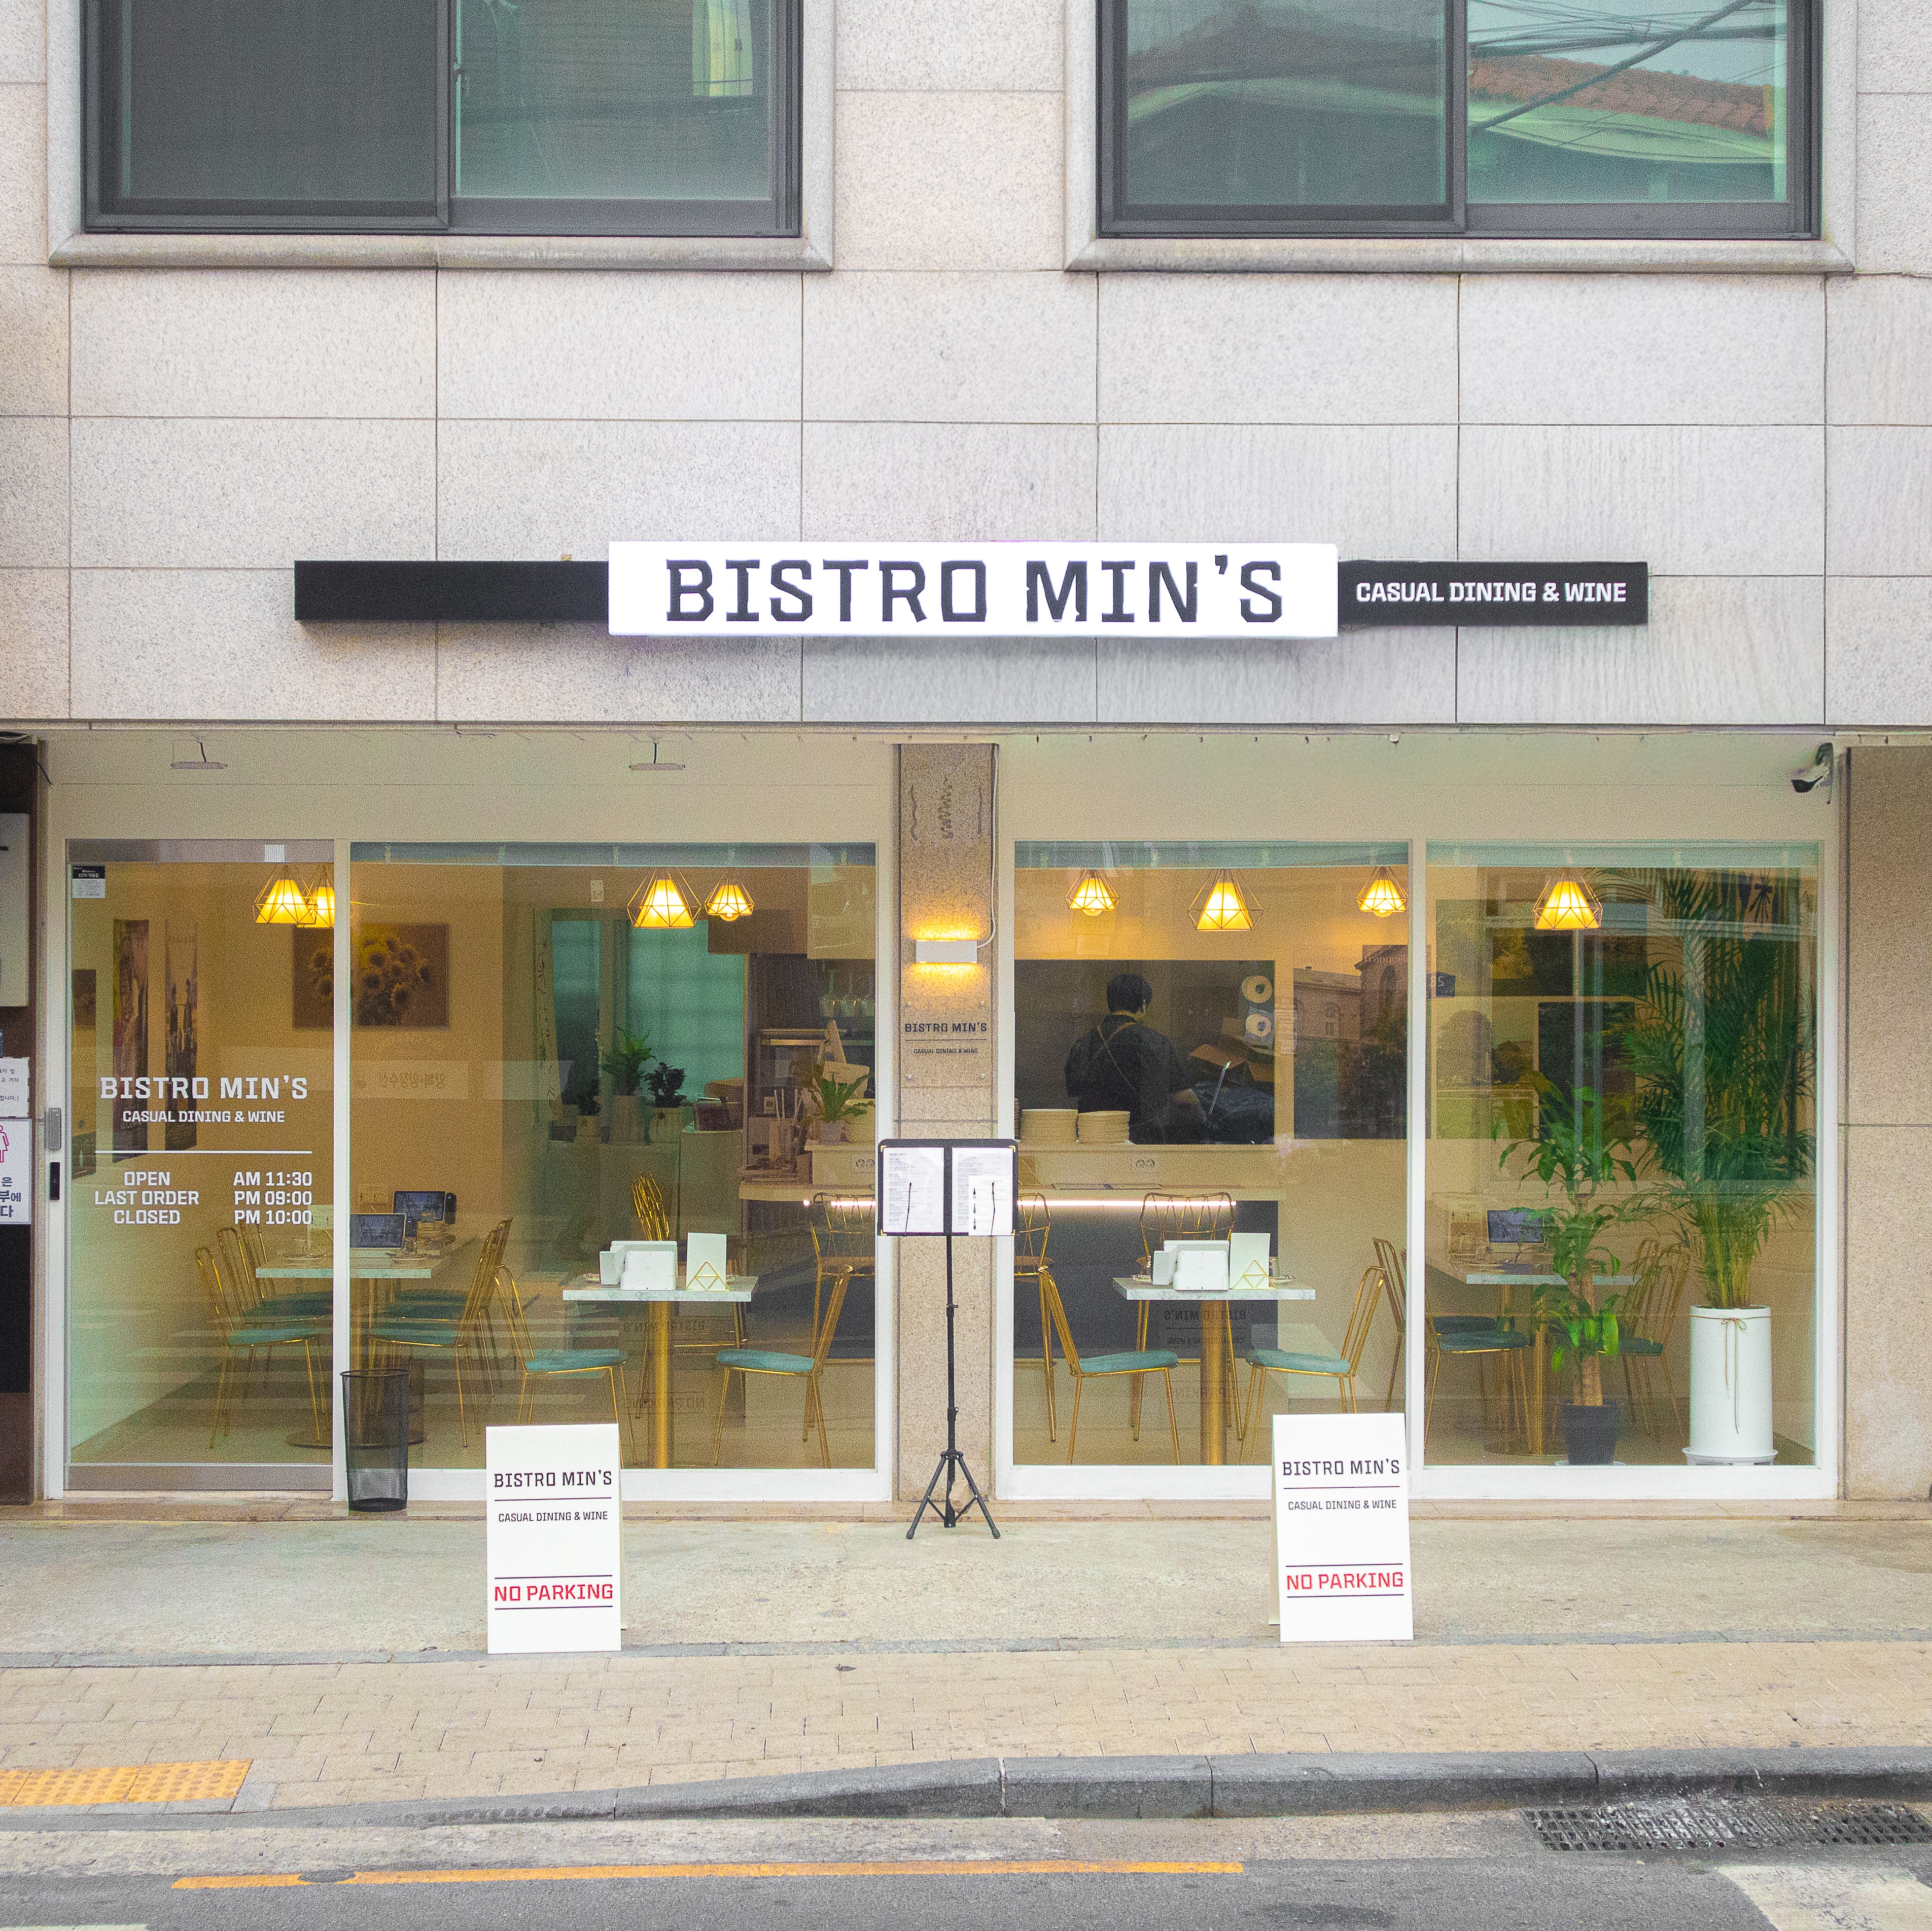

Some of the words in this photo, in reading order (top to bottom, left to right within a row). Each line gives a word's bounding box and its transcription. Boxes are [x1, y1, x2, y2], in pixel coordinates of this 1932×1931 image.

[667, 560, 987, 622] BISTRO
[1027, 555, 1282, 622] MIN'S
[1357, 583, 1444, 602] CASUAL
[1450, 583, 1536, 601] DINING
[1542, 583, 1559, 601] &
[1565, 583, 1626, 602] WINE
[905, 1023, 947, 1032] BISTRO
[952, 1022, 987, 1032] MIN'S
[100, 1077, 208, 1099] BISTRO
[221, 1075, 307, 1099] MIN'S
[123, 1111, 175, 1122] CASUAL
[179, 1111, 231, 1122] DINING
[235, 1111, 244, 1122] &
[248, 1111, 284, 1122] WINE
[124, 1172, 170, 1186] OPEN
[233, 1172, 260, 1186] AM
[266, 1172, 312, 1186] 11:30
[95, 1191, 137, 1204] LAST
[142, 1191, 198, 1204] ORDER
[235, 1191, 260, 1204] PM
[265, 1191, 312, 1204] 09:00
[114, 1210, 180, 1224] CLOSED
[234, 1210, 260, 1224] PM
[266, 1210, 312, 1224] 10:00
[1283, 1461, 1343, 1475] BISTRO
[1351, 1458, 1399, 1474] MIN'S
[495, 1473, 555, 1487] BISTRO
[563, 1470, 611, 1486] MIN'S
[1288, 1501, 1323, 1510] CASUAL
[1326, 1500, 1360, 1509] DINING
[1363, 1500, 1369, 1509] &
[1372, 1500, 1396, 1509] WINE
[499, 1513, 534, 1522] CASUAL
[537, 1512, 571, 1521] DINING
[574, 1512, 580, 1520] &
[583, 1511, 607, 1520] WINE
[1287, 1575, 1312, 1590] NO
[1318, 1572, 1403, 1589] PARKING
[495, 1586, 520, 1601] NO
[527, 1584, 613, 1600] PARKING
